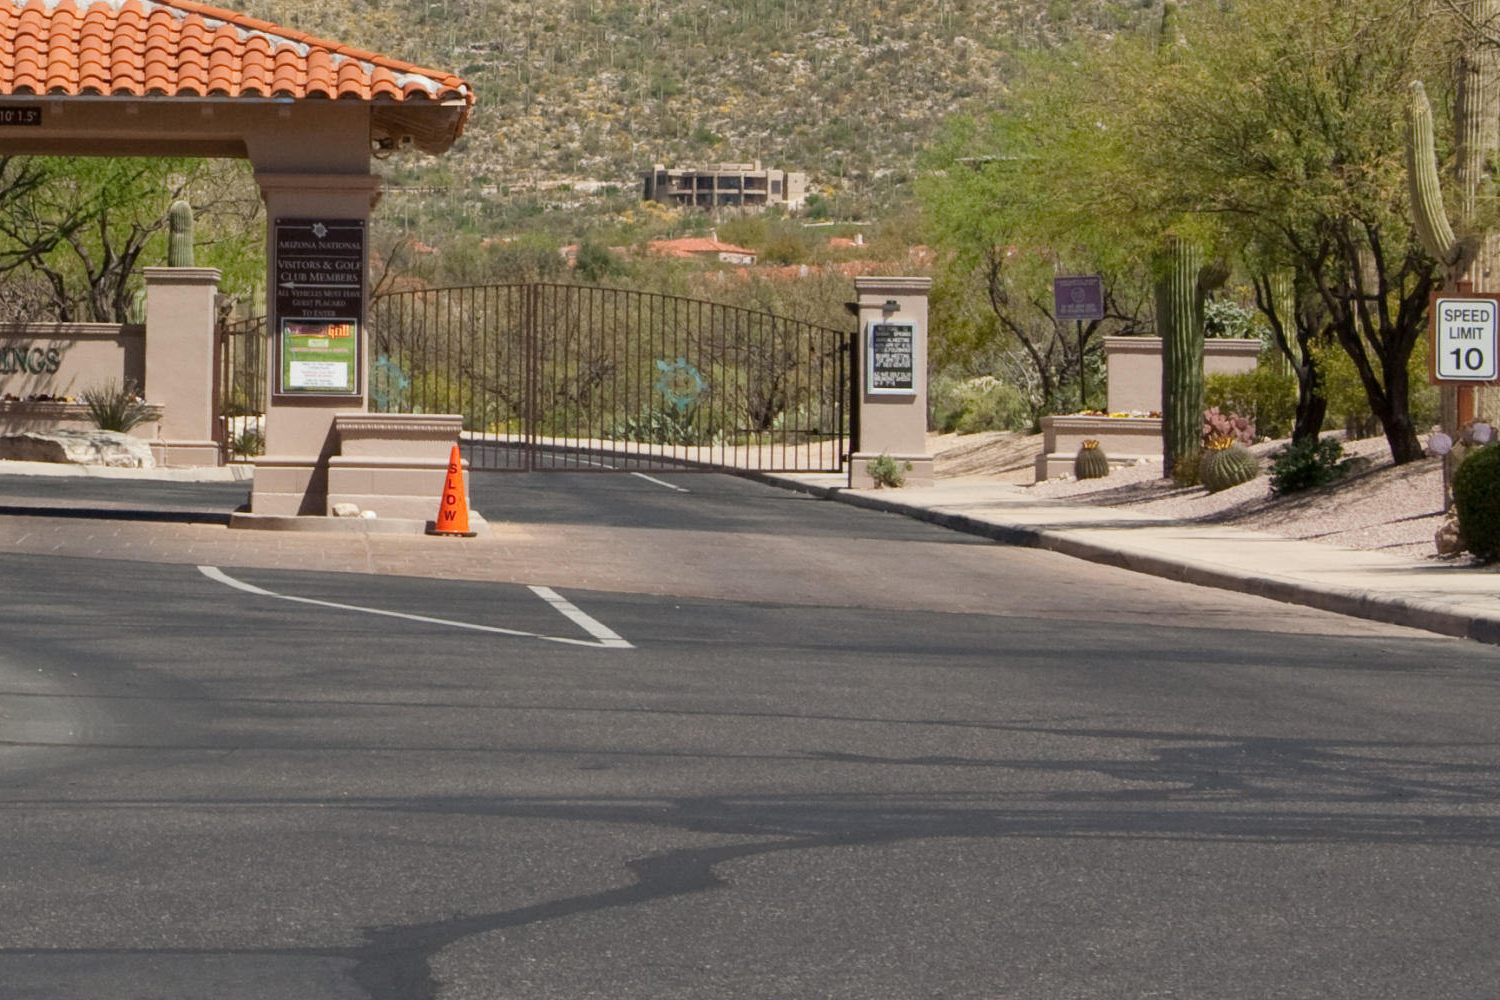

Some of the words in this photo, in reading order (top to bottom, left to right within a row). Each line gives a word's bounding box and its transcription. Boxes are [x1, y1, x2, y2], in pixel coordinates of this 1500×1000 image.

[279, 241, 316, 249] ARIZONA
[318, 241, 361, 250] NATIONAL
[278, 260, 320, 269] VISITORS
[323, 261, 332, 270] &
[335, 261, 361, 270] GOLF
[281, 272, 307, 281] CLUB
[309, 272, 358, 282] MEMBERS
[1444, 309, 1490, 322] SPEED
[1449, 327, 1484, 339] LIMIT
[1450, 347, 1484, 371] 10
[444, 463, 458, 521] SLOW
